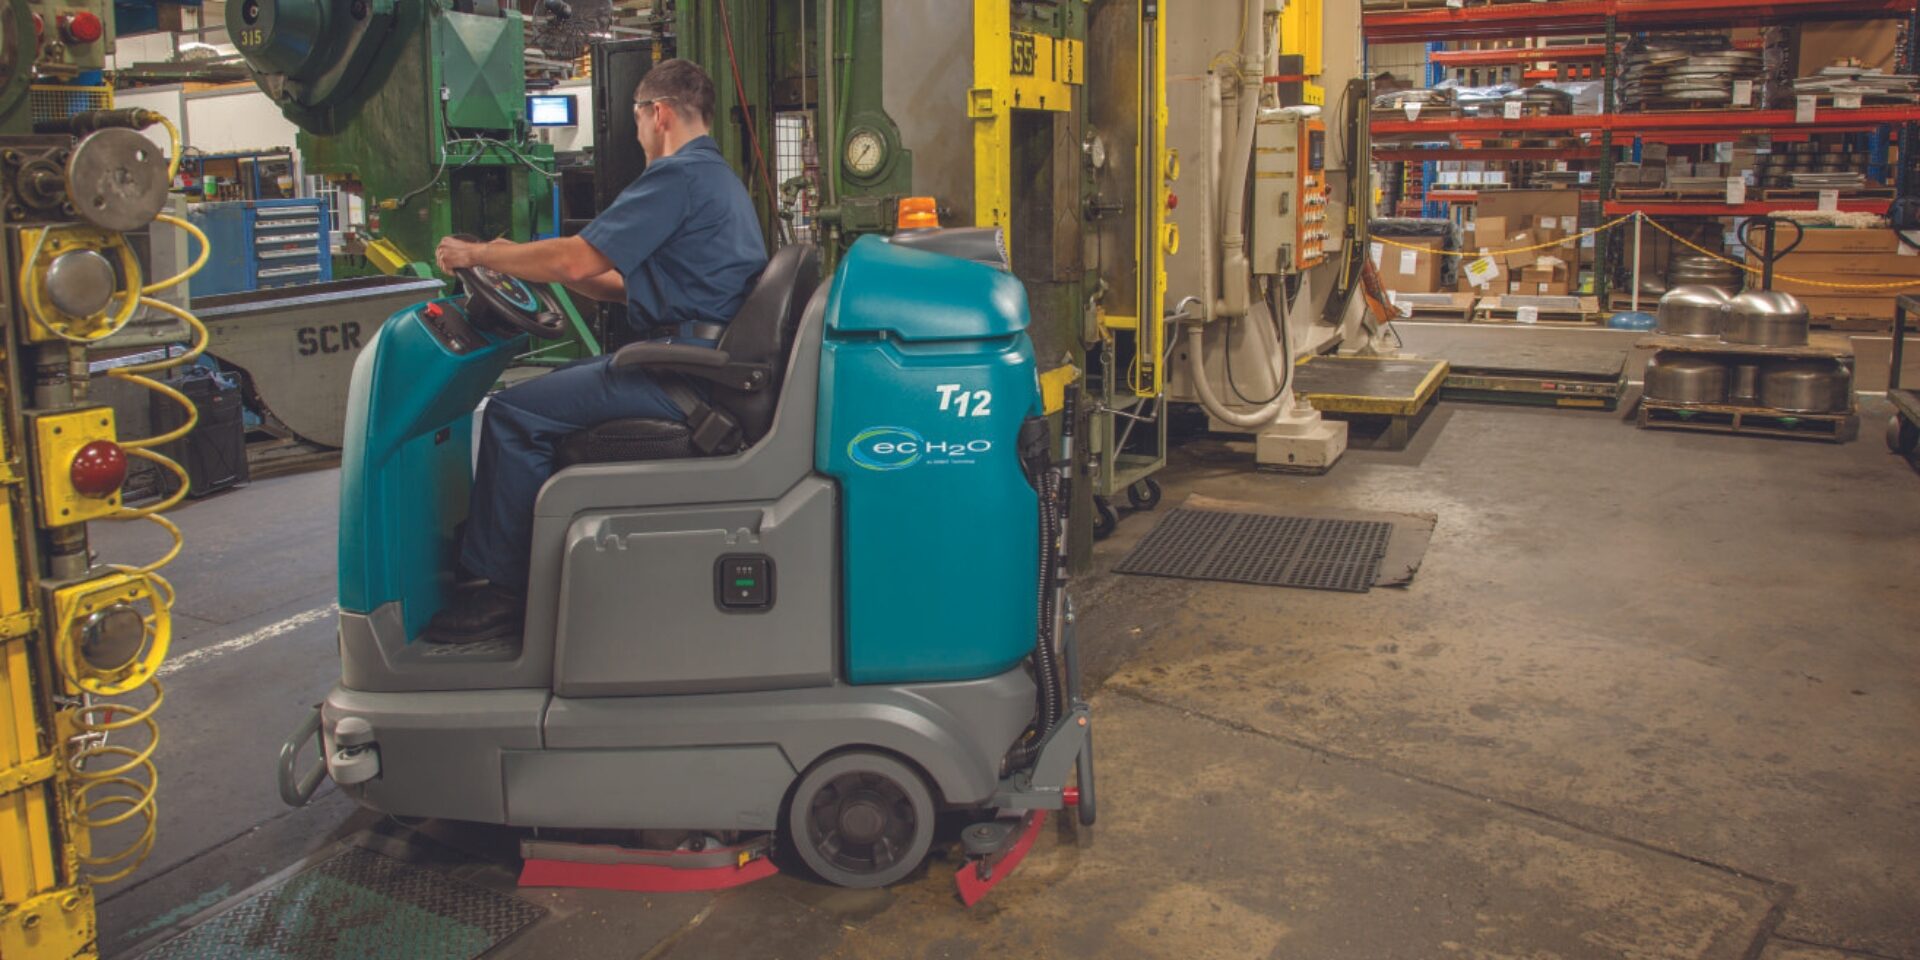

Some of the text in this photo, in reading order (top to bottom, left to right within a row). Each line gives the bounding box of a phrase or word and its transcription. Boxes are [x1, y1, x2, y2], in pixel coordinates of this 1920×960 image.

[241, 30, 262, 46] 315
[298, 321, 361, 356] SCR
[936, 384, 992, 417] T12
